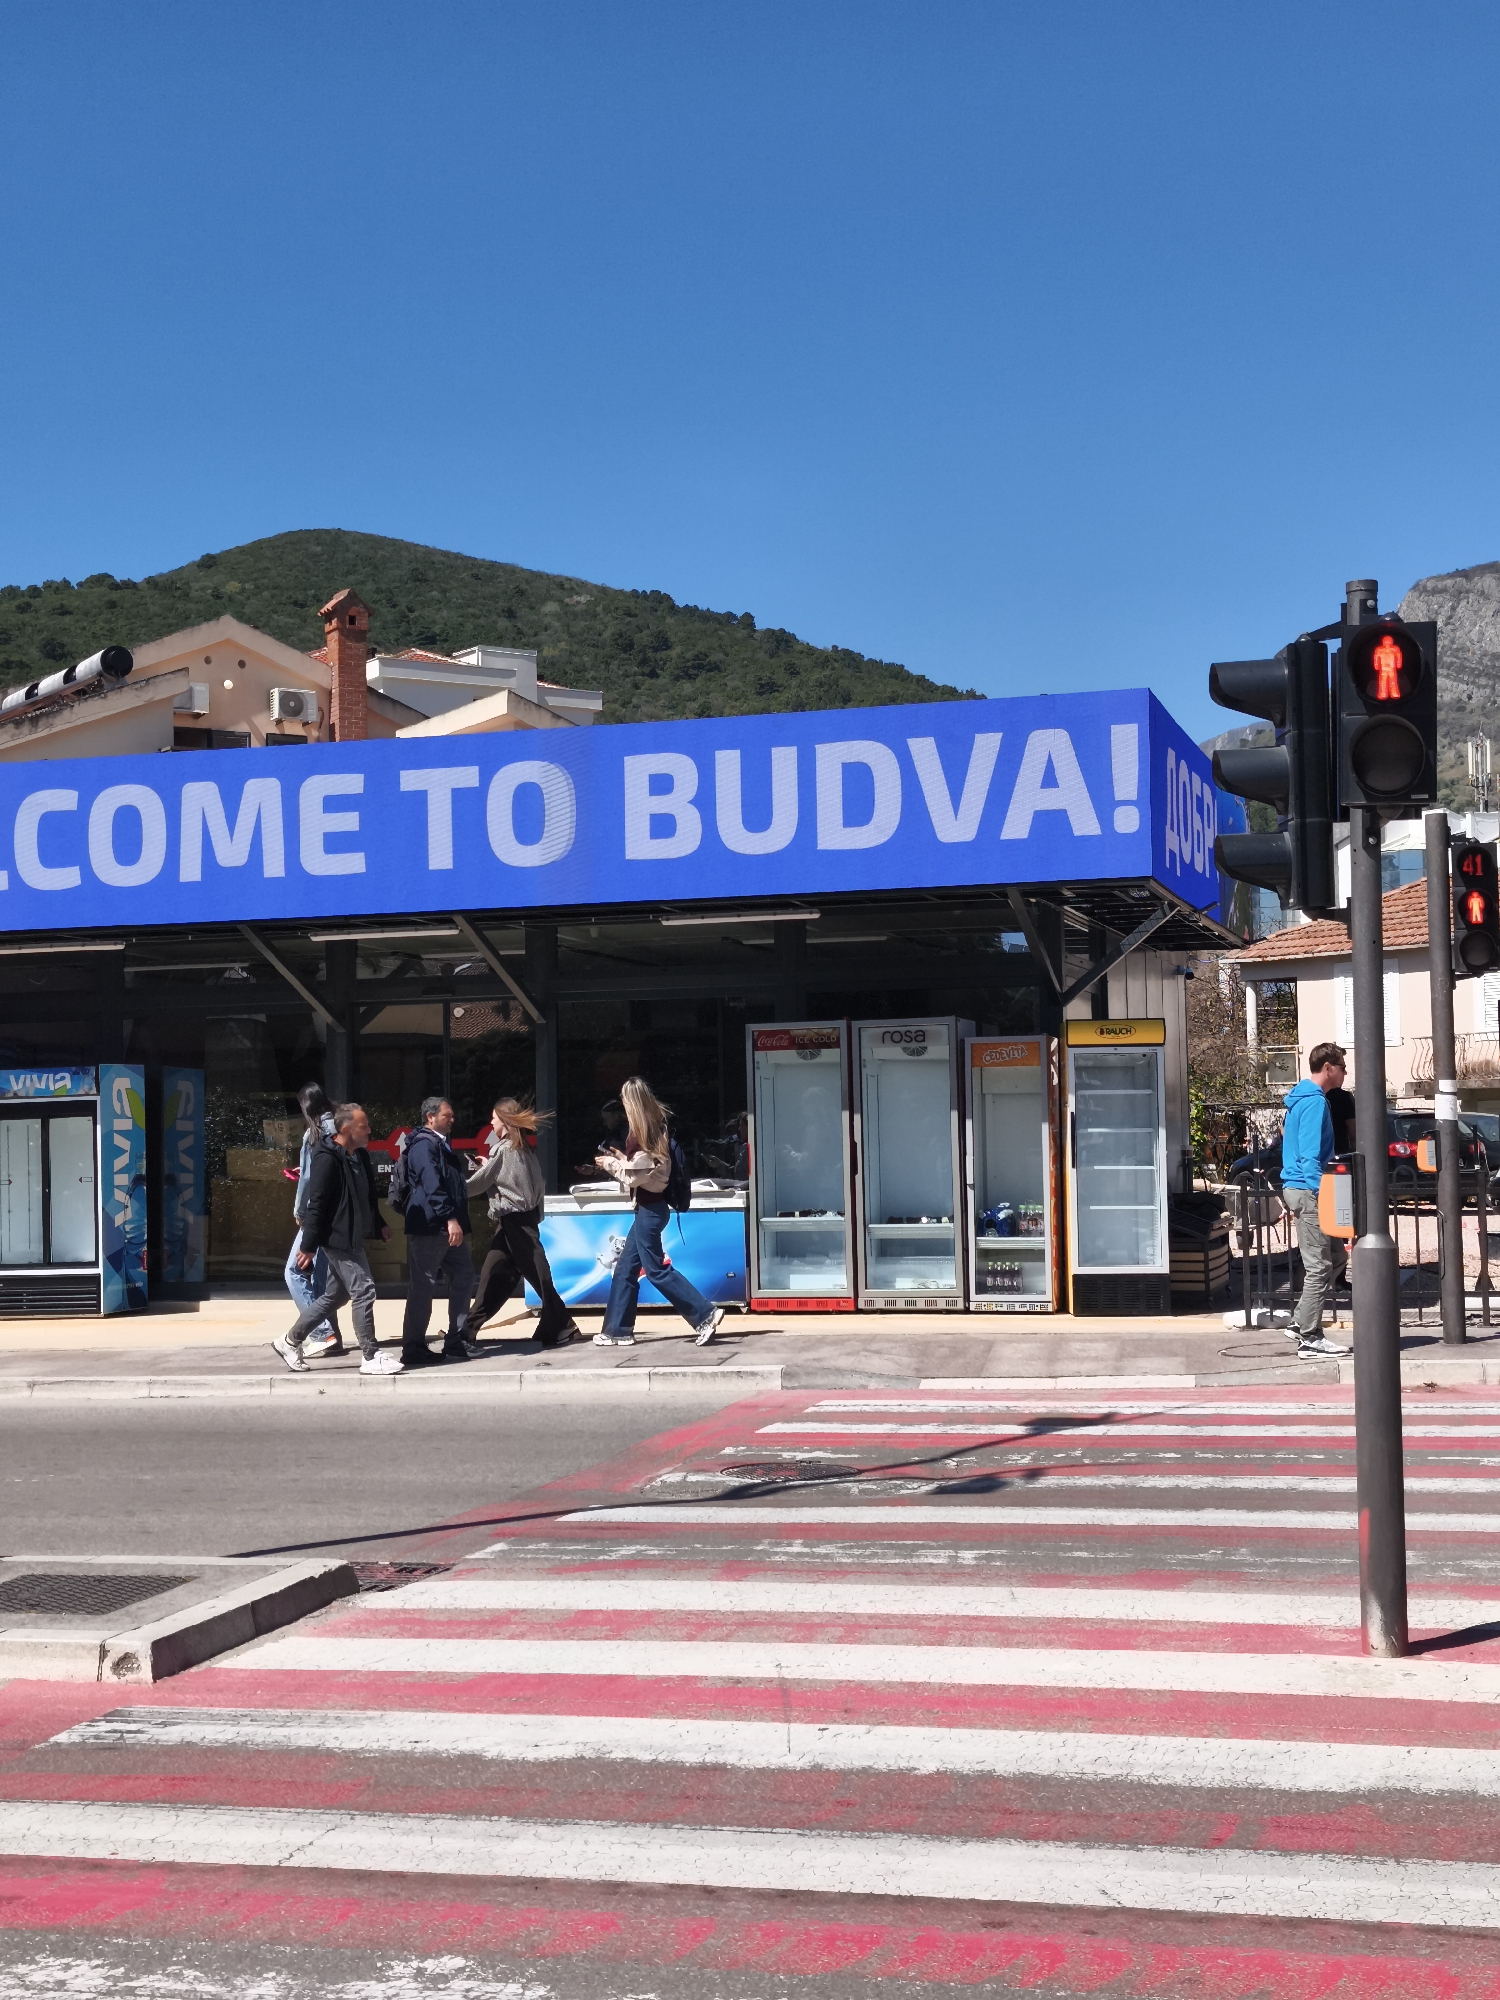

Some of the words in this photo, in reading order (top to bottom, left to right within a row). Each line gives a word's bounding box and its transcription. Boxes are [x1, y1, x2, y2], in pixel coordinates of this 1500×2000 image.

[0, 773, 366, 891] COME
[399, 760, 577, 870] TO
[623, 723, 1141, 861] BUDVA!
[1165, 746, 1219, 884] ДОБР
[1463, 853, 1483, 876] 41
[795, 1036, 810, 1044] ICE
[812, 1035, 837, 1043] COLD
[882, 1029, 926, 1044] rosa
[1105, 1027, 1132, 1036] RAUCH
[983, 1045, 1028, 1065] CEDEVITA
